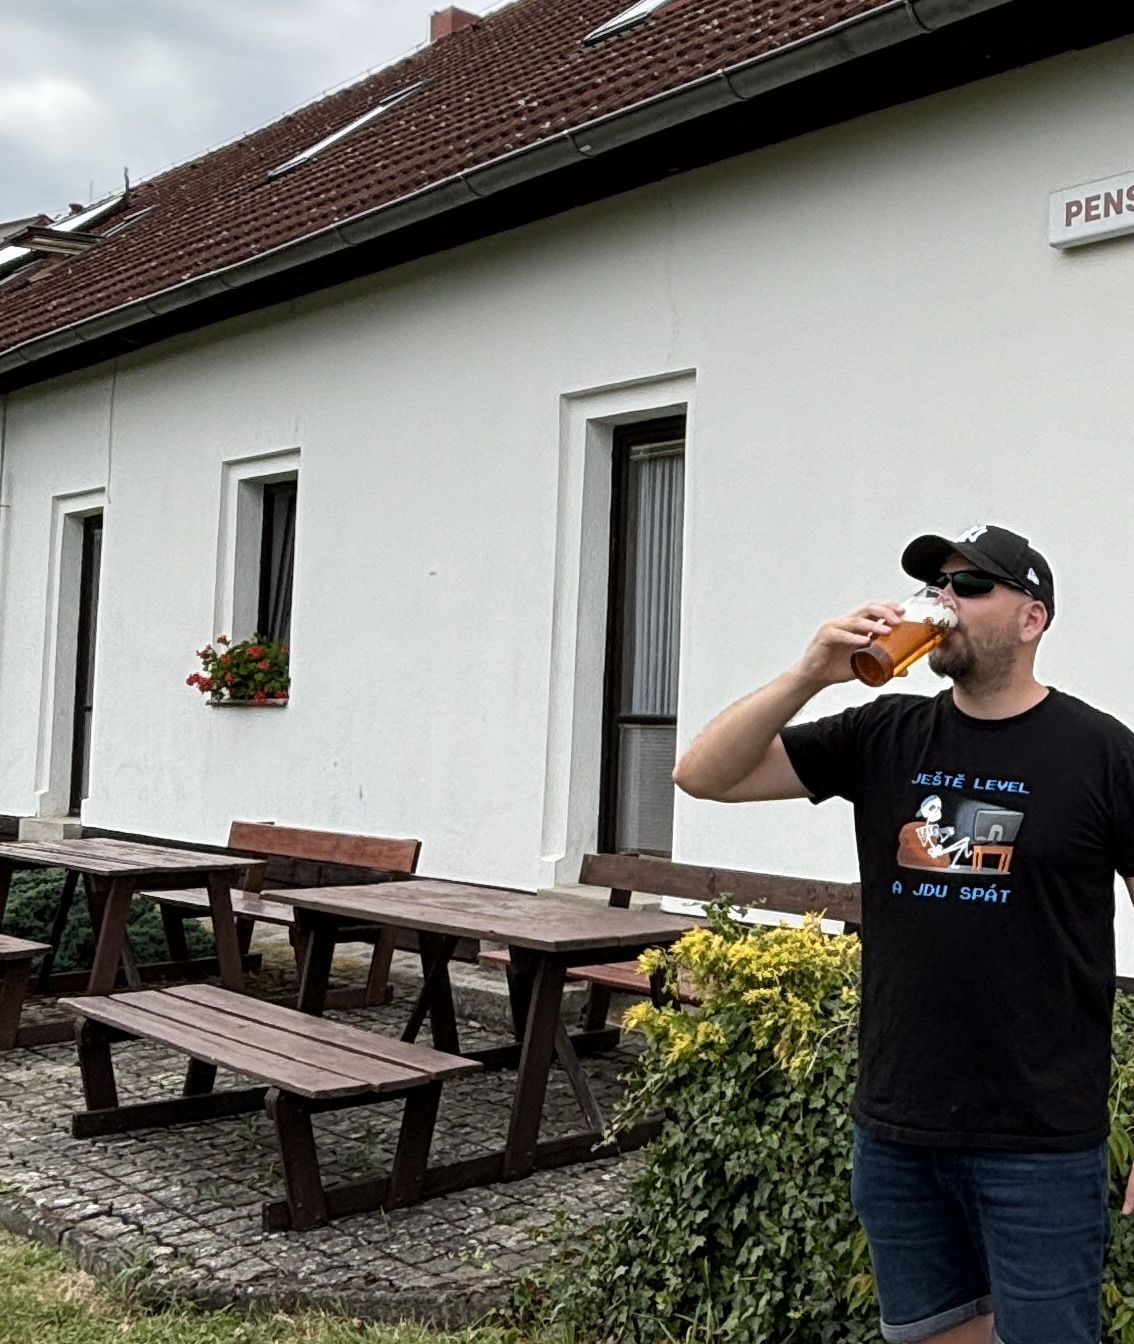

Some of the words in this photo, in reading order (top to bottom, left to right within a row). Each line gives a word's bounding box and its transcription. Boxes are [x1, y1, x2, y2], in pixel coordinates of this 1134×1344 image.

[911, 771, 966, 789] JEŠTĚ
[973, 777, 1031, 794] LEVEL
[892, 880, 903, 895] A
[912, 882, 949, 899] JDU
[959, 884, 1012, 904] SPÁT
